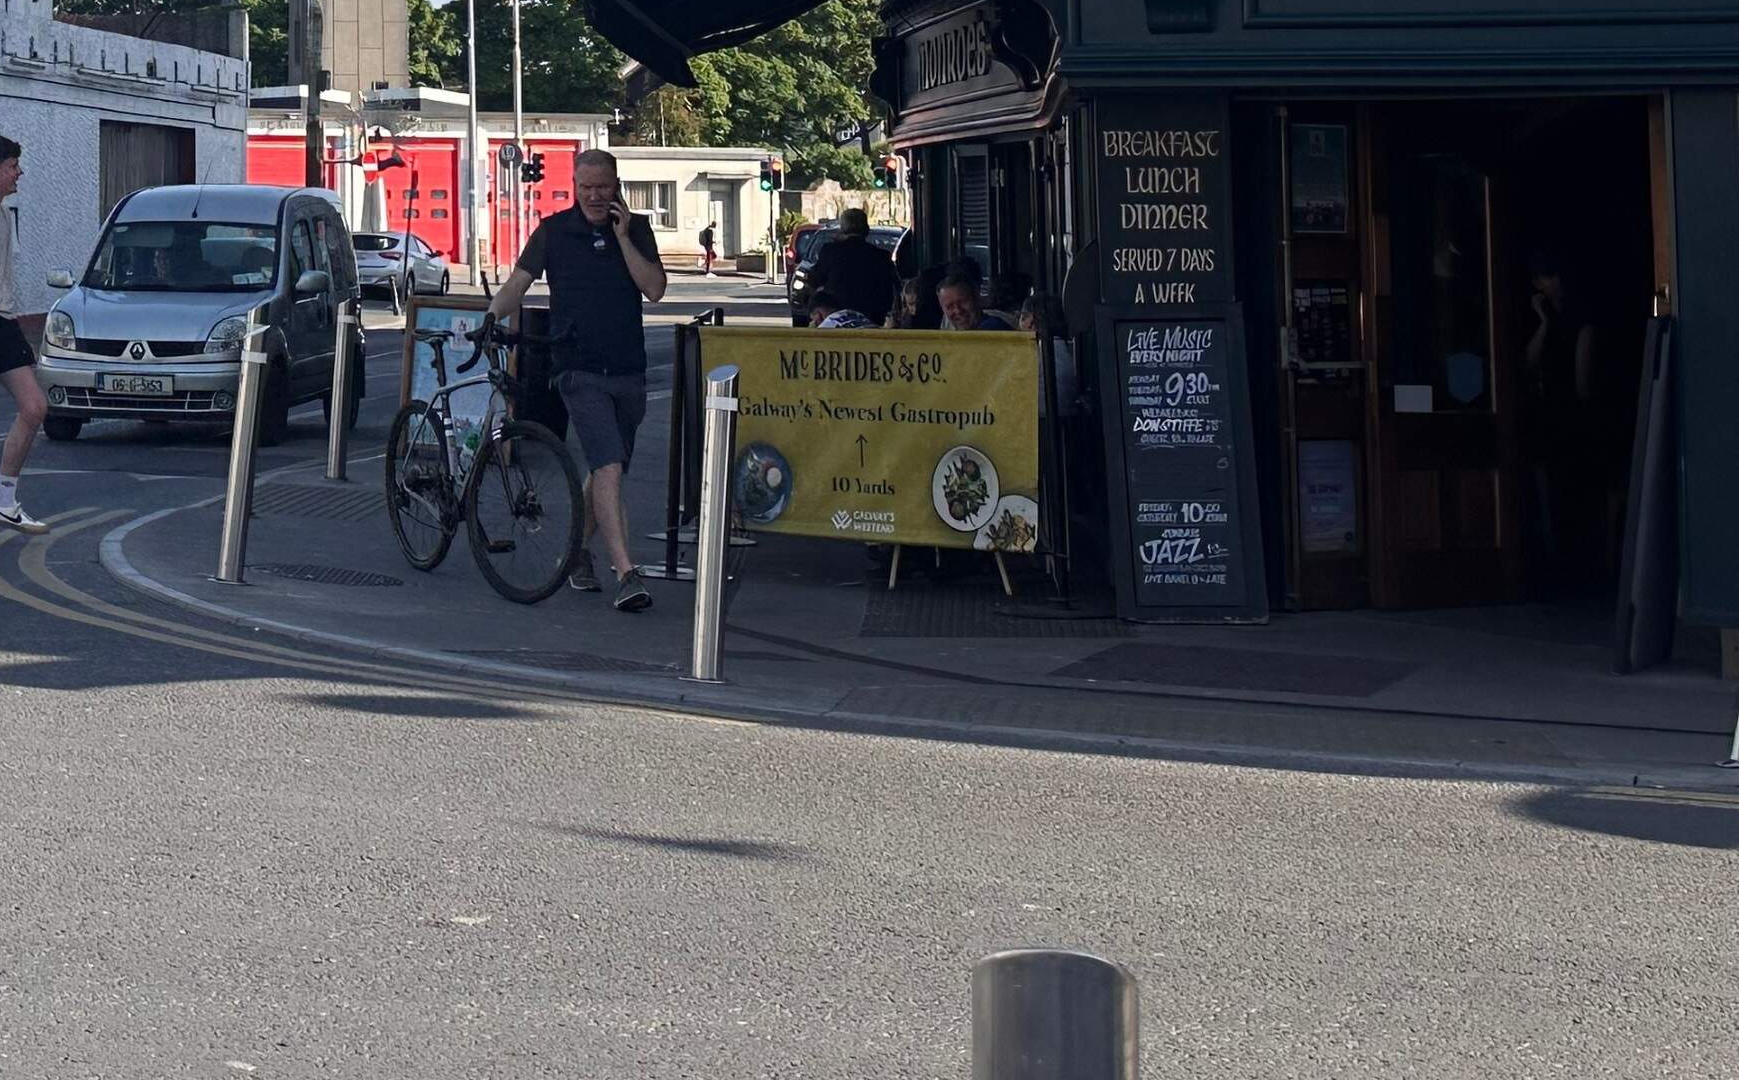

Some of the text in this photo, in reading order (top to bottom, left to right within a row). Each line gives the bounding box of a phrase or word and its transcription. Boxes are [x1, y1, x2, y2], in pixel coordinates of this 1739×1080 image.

[1103, 130, 1220, 157] BREAKFAST
[1125, 167, 1200, 193] LUNCH
[1120, 204, 1208, 230] DINNER
[1113, 248, 1215, 271] SERVED 7 DAYS
[1134, 282, 1196, 304] A WEEK
[1127, 326, 1212, 352] LIVE MUSIC
[738, 396, 995, 430] Galway's Newest Gastropub
[831, 476, 895, 496] 10 Yards
[1139, 537, 1205, 564] JAZZ
